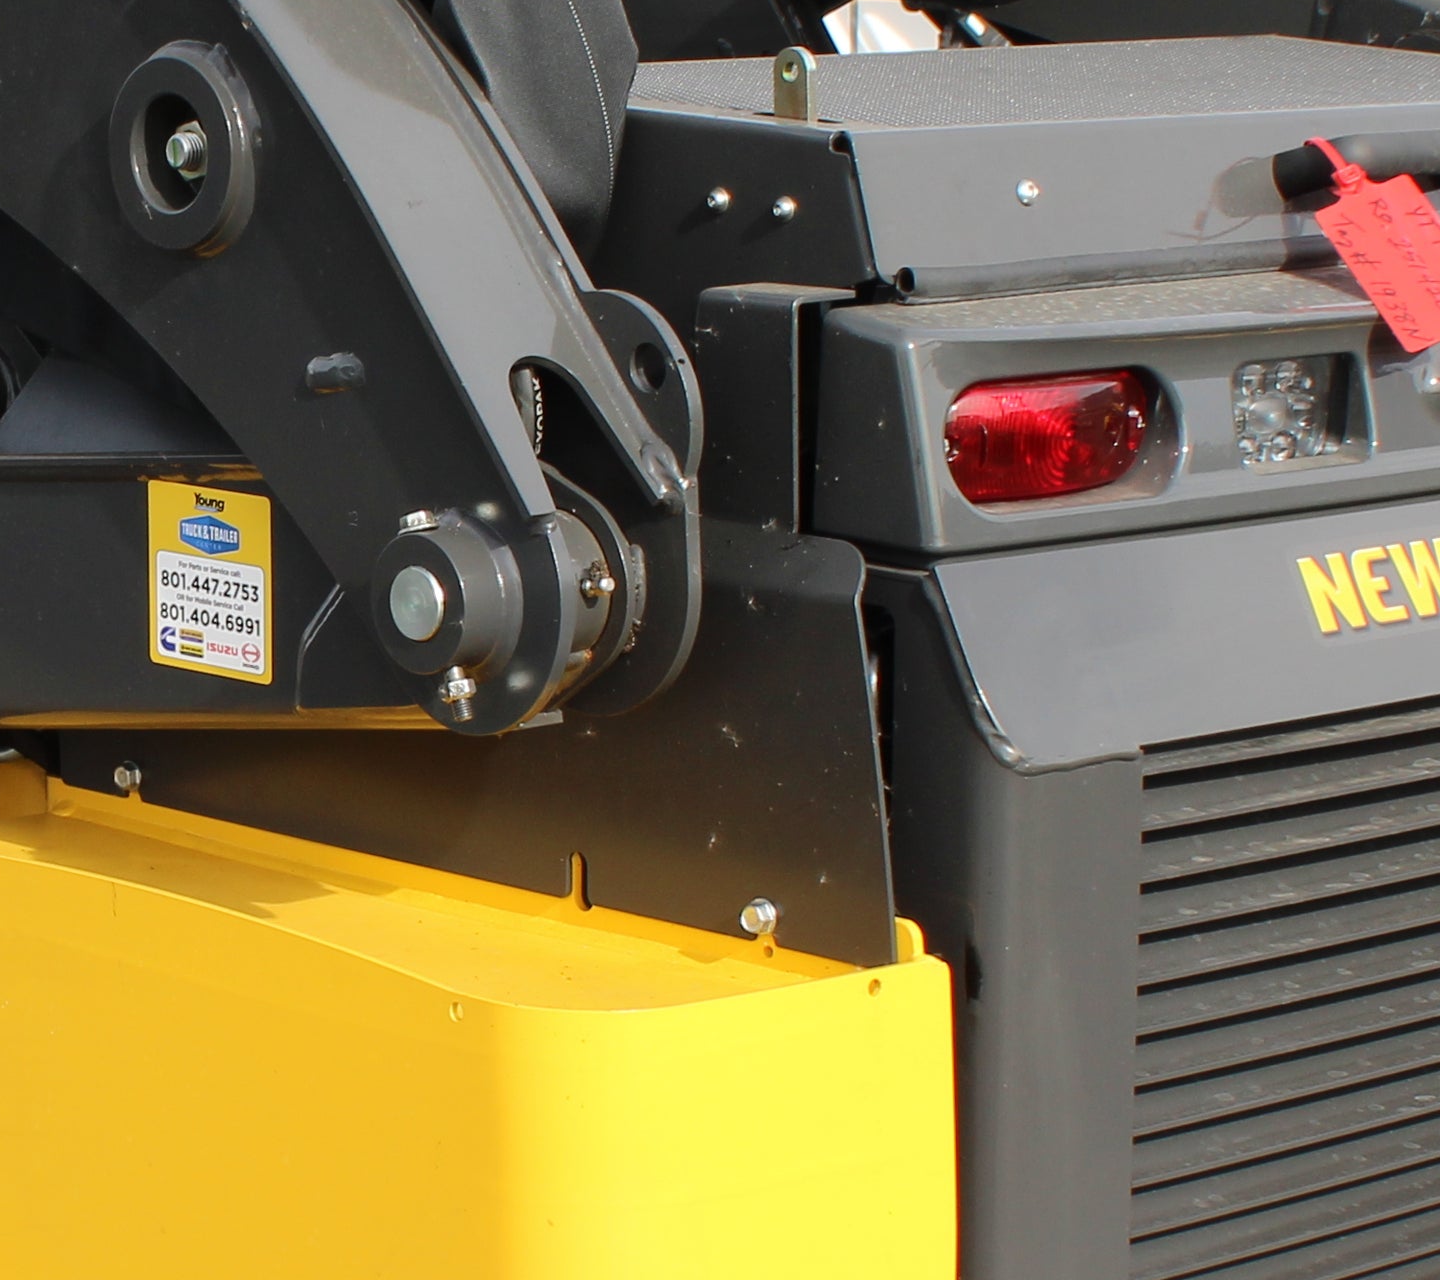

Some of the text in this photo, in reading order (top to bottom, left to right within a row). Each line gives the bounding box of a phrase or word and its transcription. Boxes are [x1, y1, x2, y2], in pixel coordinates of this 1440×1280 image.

[194, 492, 225, 512] Young
[188, 562, 202, 571] Parts
[210, 566, 229, 576] Service
[160, 570, 259, 602] 801.447.2753
[213, 600, 232, 610] Service
[160, 602, 260, 637] 801.404.6991
[206, 642, 239, 656] ISUZU
